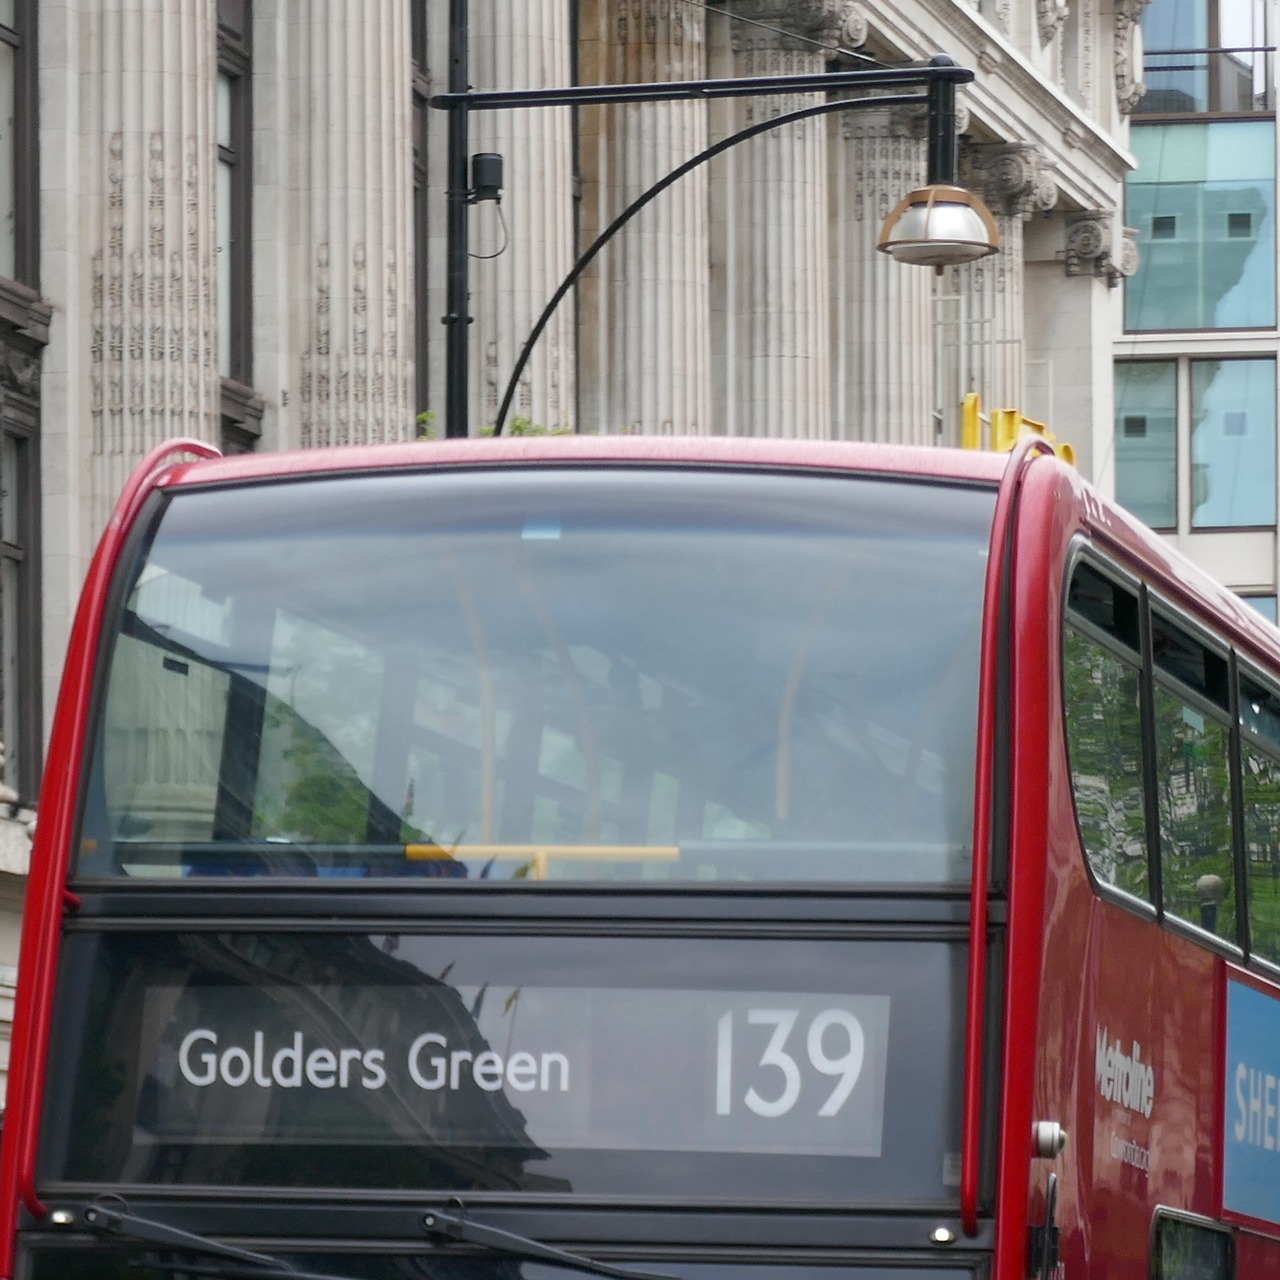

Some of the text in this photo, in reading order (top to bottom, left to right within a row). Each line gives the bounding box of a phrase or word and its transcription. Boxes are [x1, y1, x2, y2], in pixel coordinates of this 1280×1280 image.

[178, 1029, 570, 1092] Golders Green
[716, 1007, 865, 1118] 139
[1095, 1023, 1154, 1119] Metroline
